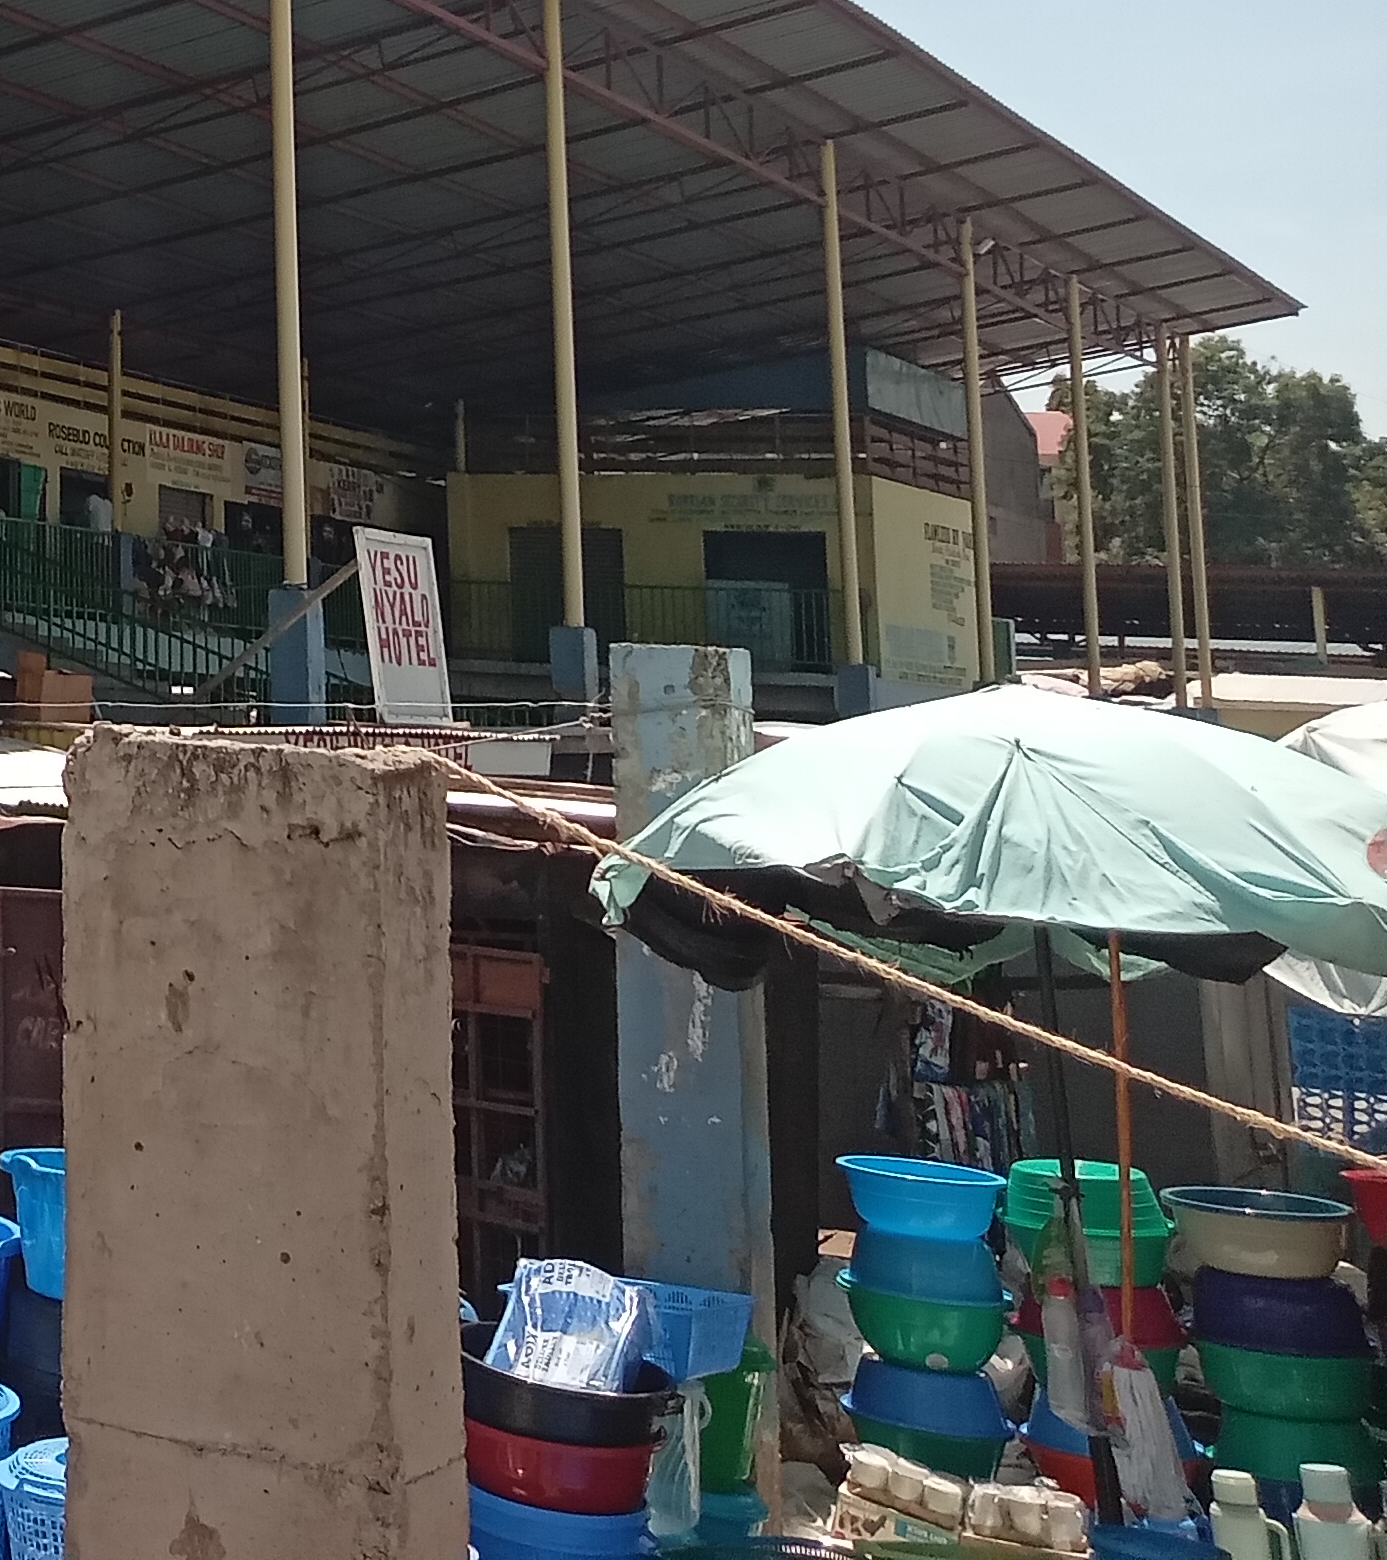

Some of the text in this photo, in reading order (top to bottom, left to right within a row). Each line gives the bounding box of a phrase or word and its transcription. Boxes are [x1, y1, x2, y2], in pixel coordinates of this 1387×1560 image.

[3, 399, 36, 421] WORLD
[48, 422, 91, 445] ROSEBUD
[366, 548, 419, 591] YESU
[372, 587, 430, 629] NYALO
[376, 626, 437, 668] HOTEL
